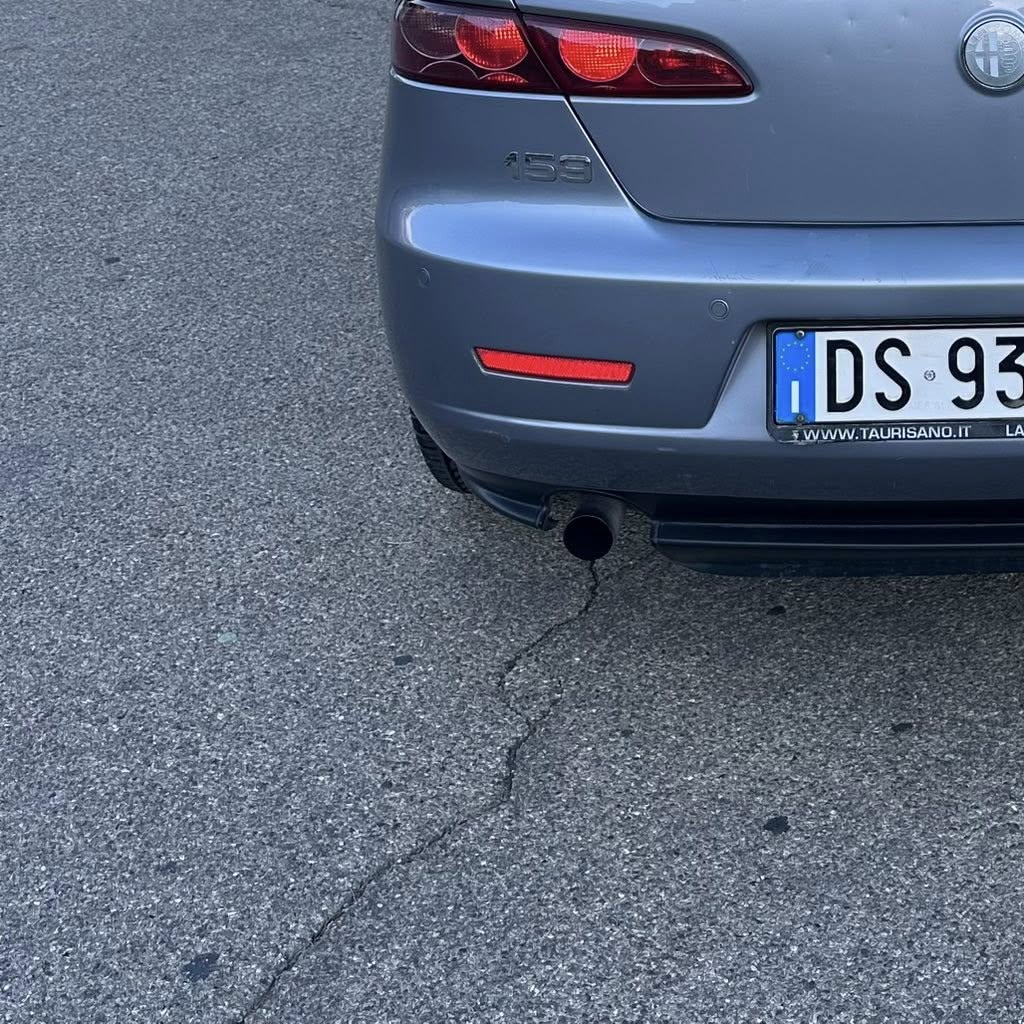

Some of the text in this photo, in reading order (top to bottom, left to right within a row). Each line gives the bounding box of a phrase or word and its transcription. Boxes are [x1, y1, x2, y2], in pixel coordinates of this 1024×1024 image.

[504, 151, 593, 184] 159
[826, 337, 912, 413] DS
[803, 425, 972, 441] WWW.TAURISANO.IT
[1006, 424, 1024, 437] LA
